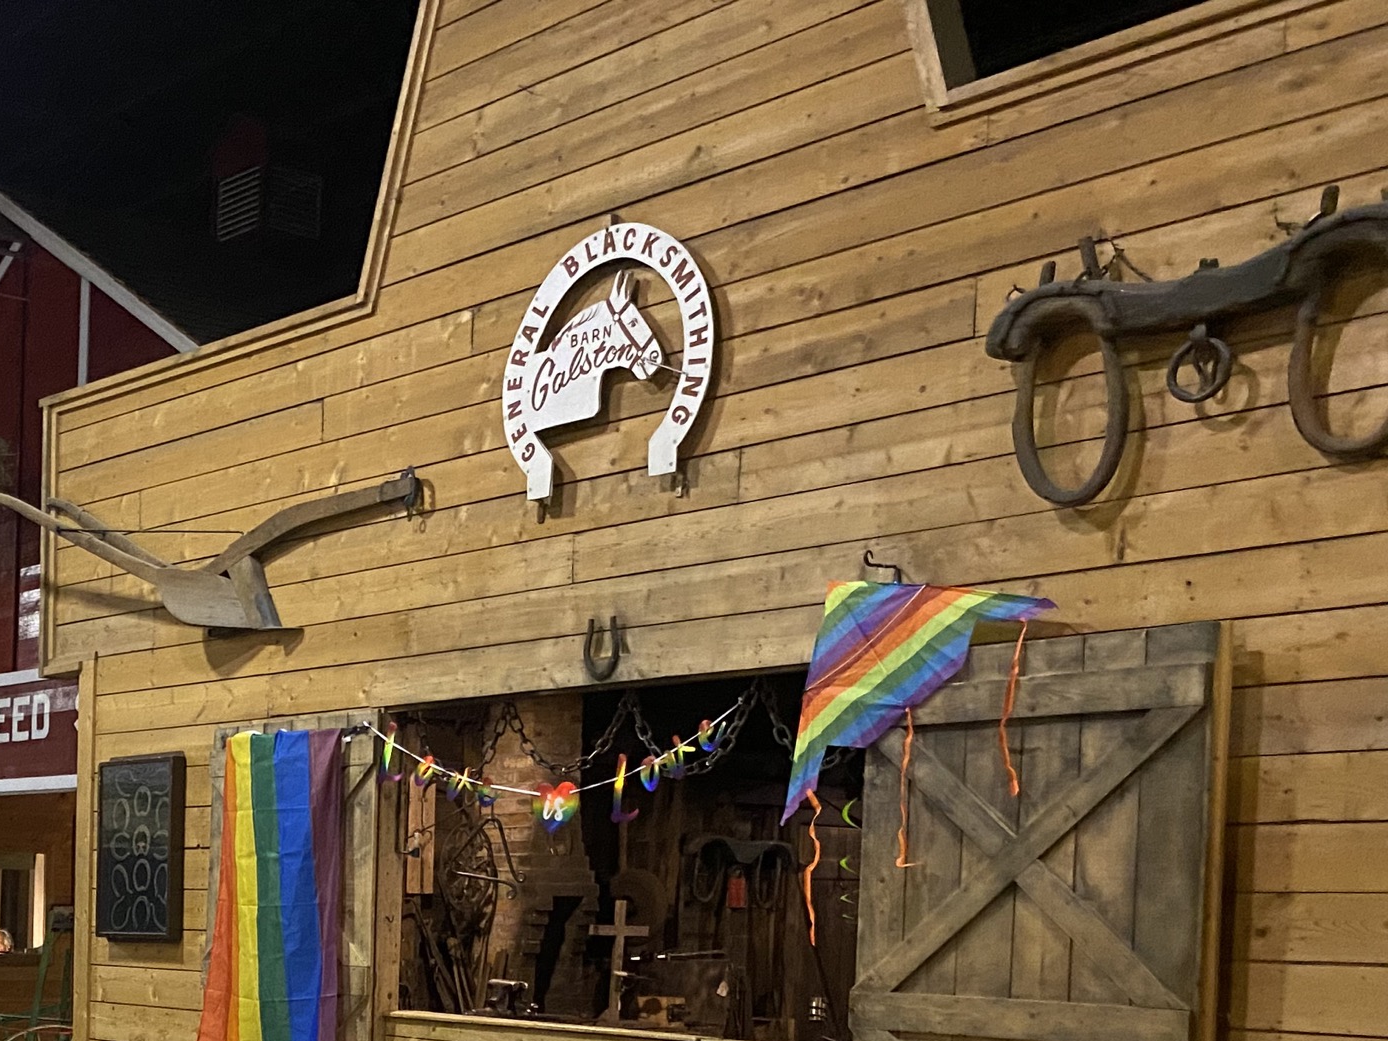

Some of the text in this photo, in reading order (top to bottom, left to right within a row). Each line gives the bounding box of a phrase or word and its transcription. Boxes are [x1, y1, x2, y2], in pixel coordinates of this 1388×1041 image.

[507, 227, 709, 462] GENERAL BLACKSMITHING
[570, 324, 612, 348] BARN
[531, 342, 636, 411] Galston
[542, 794, 569, 822] is
